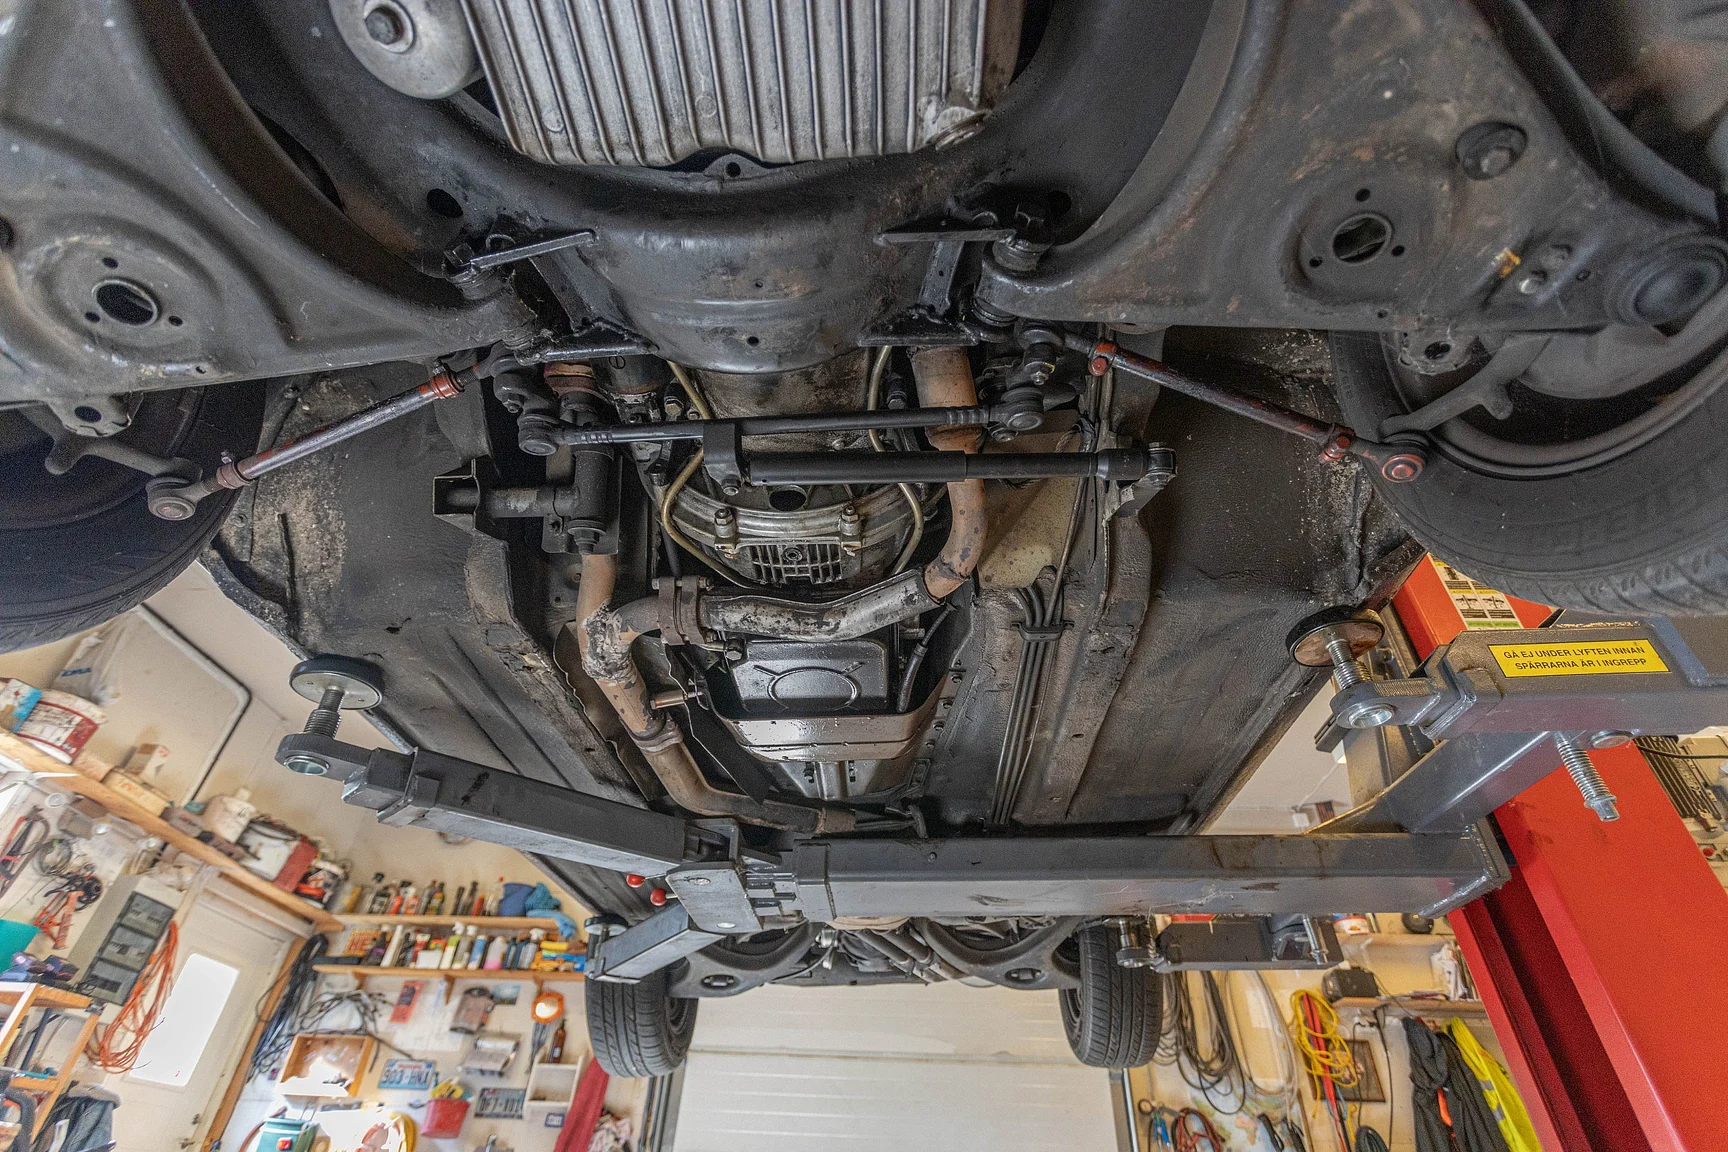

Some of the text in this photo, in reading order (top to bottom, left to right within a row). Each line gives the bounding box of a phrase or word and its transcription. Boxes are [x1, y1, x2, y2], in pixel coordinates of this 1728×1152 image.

[1503, 646, 1645, 659] GÅ EJ UNDER LYFTEN INNAN
[1515, 660, 1579, 670] SPÄRRARNA
[1580, 658, 1595, 668] ÄR
[1601, 658, 1647, 667] INGREPP
